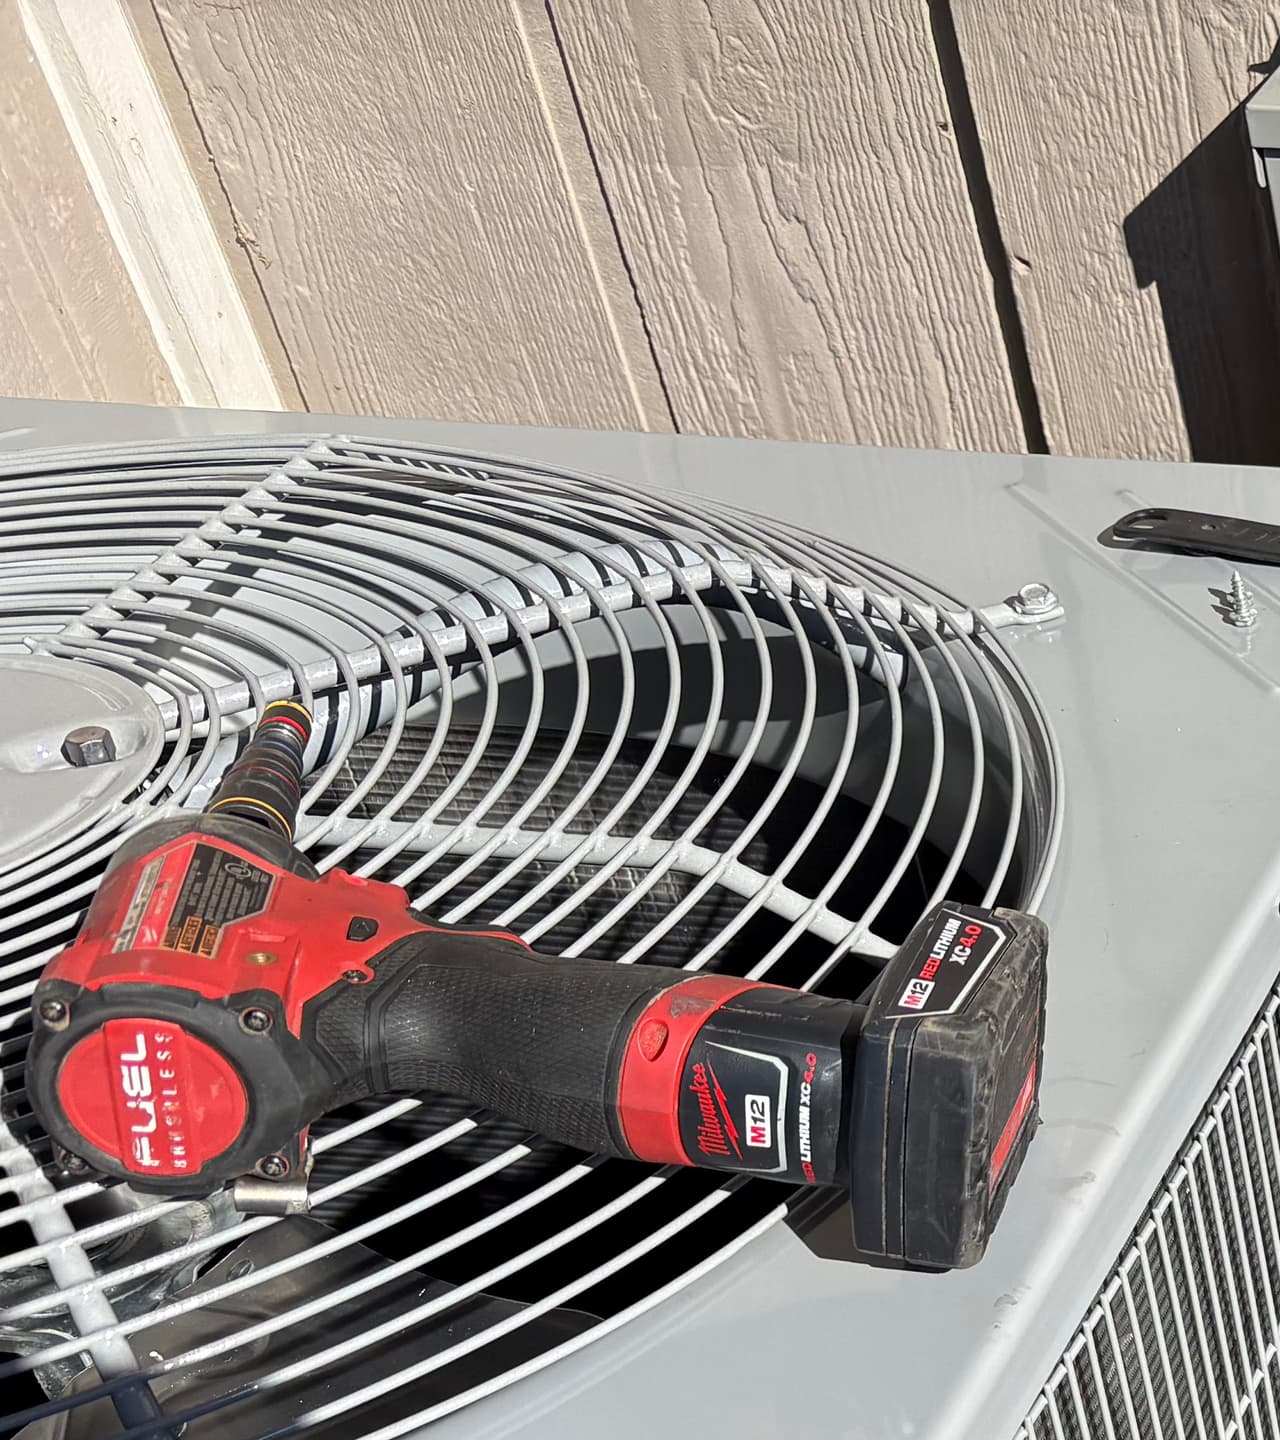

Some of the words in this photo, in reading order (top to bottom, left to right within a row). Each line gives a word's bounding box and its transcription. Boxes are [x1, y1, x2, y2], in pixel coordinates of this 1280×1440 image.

[903, 980, 930, 1007] M12
[919, 918, 963, 980] REDLITHIUM
[949, 924, 983, 967] XC4.0
[120, 1033, 160, 1167] FUEL
[689, 1062, 732, 1157] Milwaukee
[800, 1052, 817, 1107] XC4.0
[750, 1098, 768, 1145] M12
